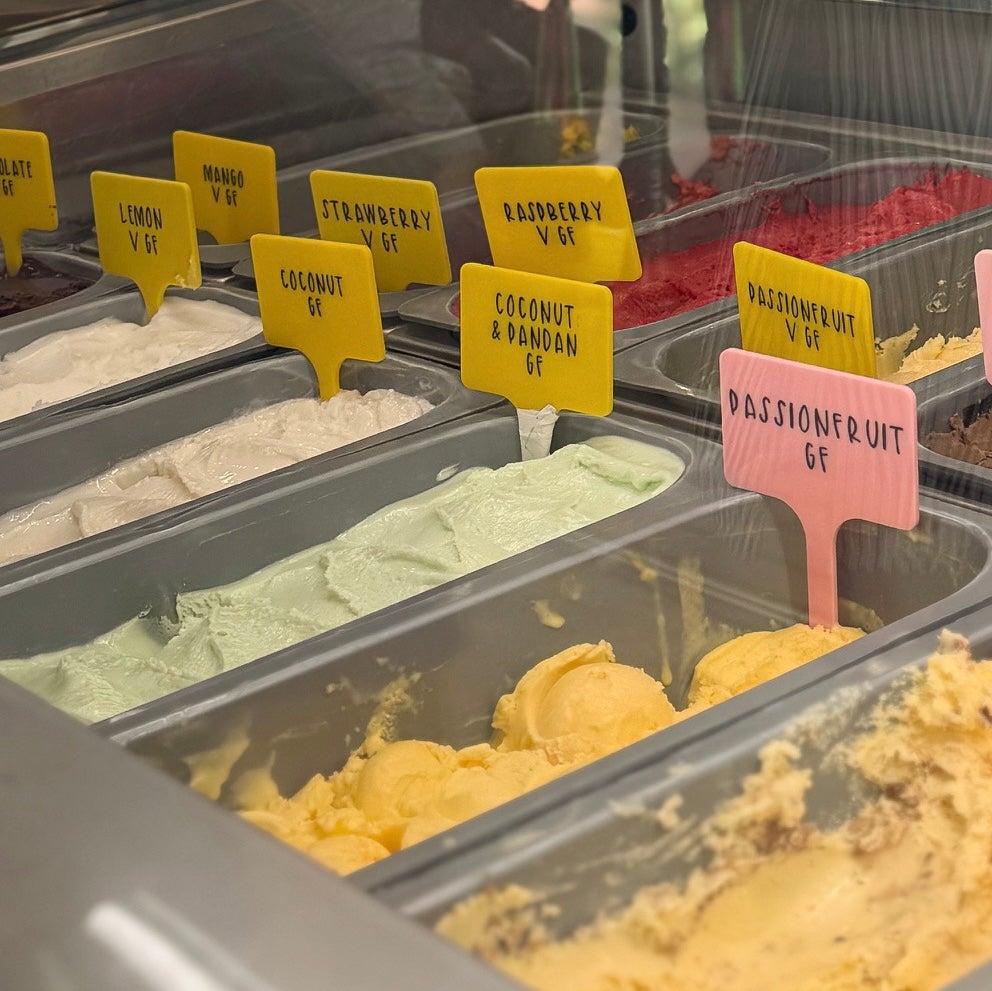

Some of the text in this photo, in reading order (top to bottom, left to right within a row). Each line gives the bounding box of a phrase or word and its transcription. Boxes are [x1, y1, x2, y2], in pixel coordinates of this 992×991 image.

[203, 163, 244, 189] MANGO
[212, 186, 239, 207] V GF
[119, 202, 163, 230] LEMON
[322, 198, 431, 232] STRAWBERRY
[504, 200, 602, 223] RASPBERRY
[128, 231, 158, 256] V GF
[360, 228, 399, 254] V GF
[536, 225, 576, 247] V GF
[280, 268, 345, 298] COCONUT
[307, 296, 323, 318] GF
[495, 292, 575, 327] COCONUT
[748, 281, 856, 338] PASSIONFRUIT
[491, 322, 578, 357] & PANDAN
[785, 318, 821, 352] V GF
[526, 355, 544, 377] GF
[728, 388, 905, 456] PASSIONFRUIT
[805, 442, 830, 474] GF
